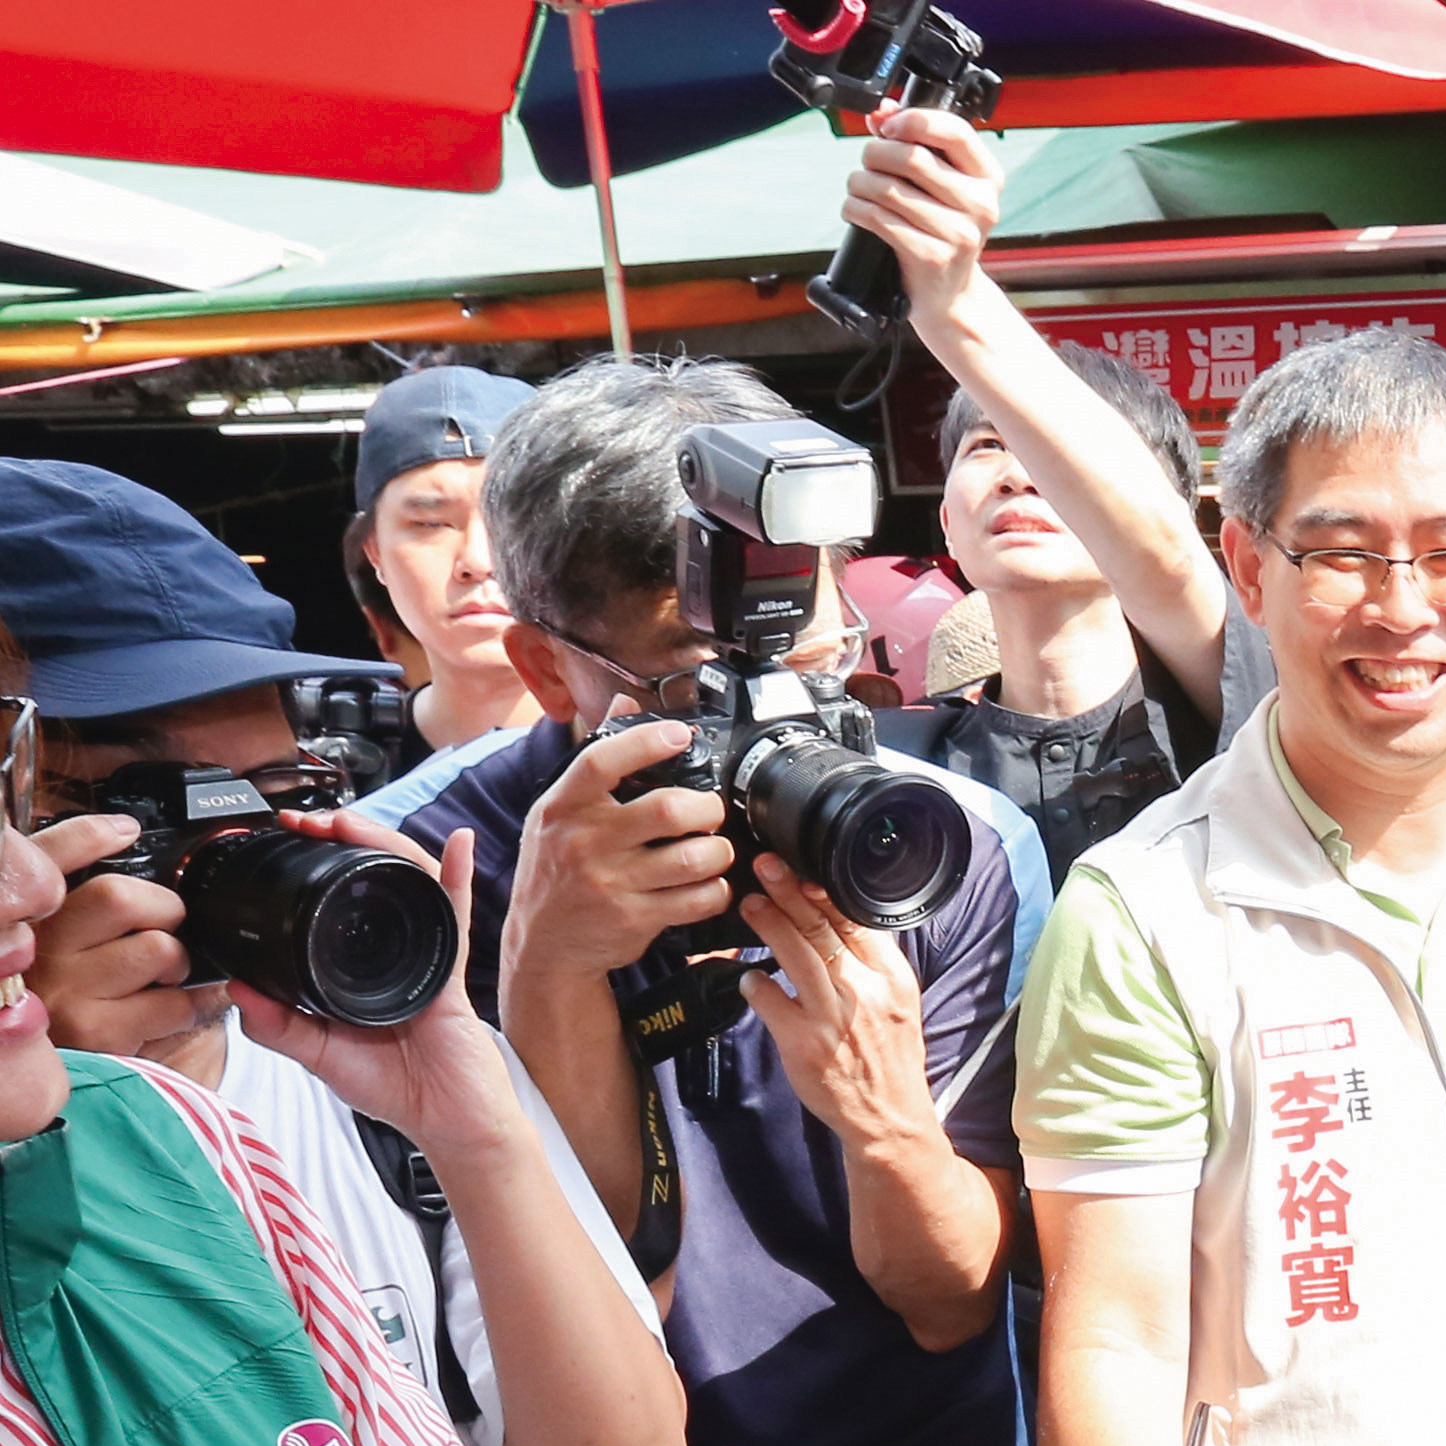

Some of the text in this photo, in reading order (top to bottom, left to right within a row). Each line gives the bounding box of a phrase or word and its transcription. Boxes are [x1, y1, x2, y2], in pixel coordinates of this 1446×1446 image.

[756, 600, 794, 613] Nikon
[198, 793, 250, 809] SONY
[1342, 1067, 1373, 1124] 主任
[1269, 1069, 1360, 1328] 李裕寬
